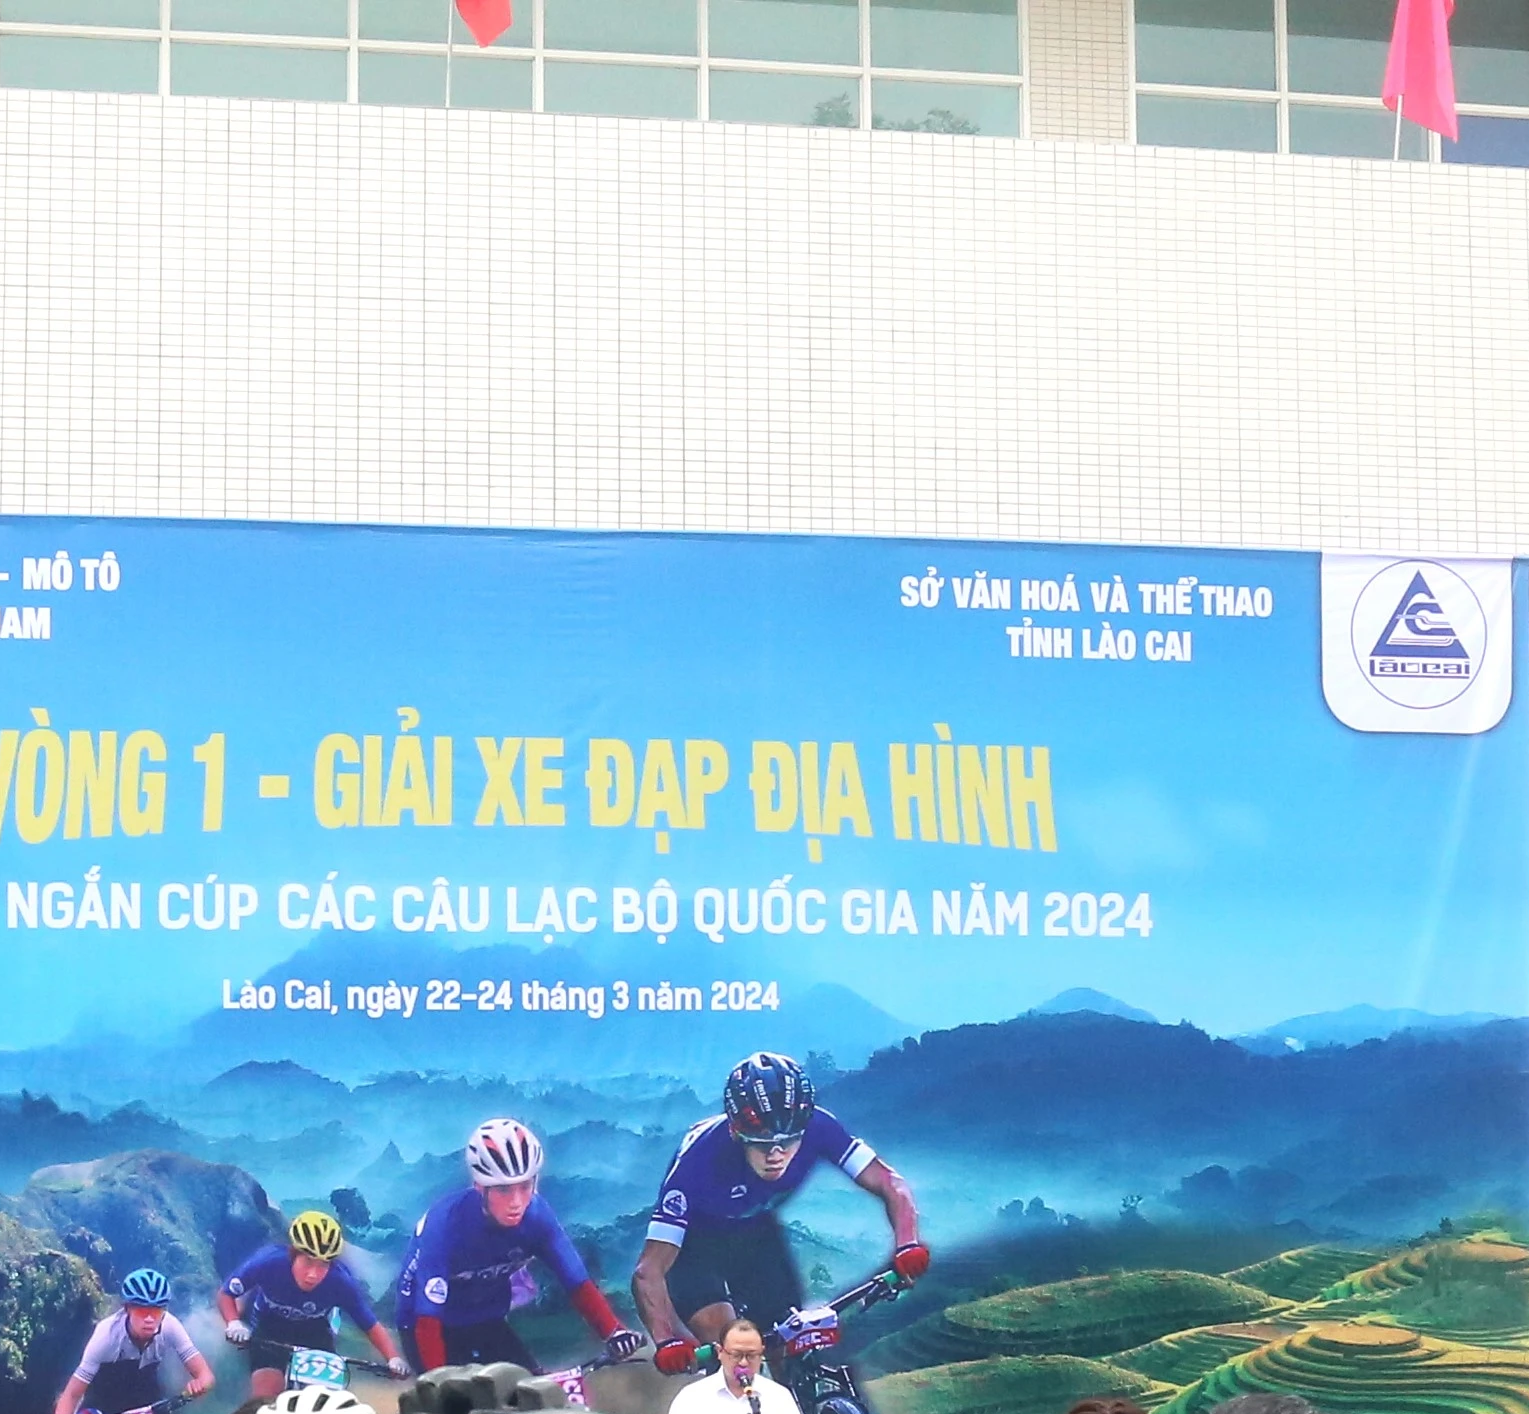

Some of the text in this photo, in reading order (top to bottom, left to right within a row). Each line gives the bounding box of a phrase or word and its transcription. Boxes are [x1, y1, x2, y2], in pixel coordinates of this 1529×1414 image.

[22, 550, 72, 591] MÔ
[79, 551, 121, 591] TÔ
[900, 565, 1273, 617] SỞ VĂN HOÁ VÀ THỂ THAO
[1006, 616, 1192, 662] TỈNH LÀO CAI
[193, 732, 225, 832] 1
[259, 775, 290, 797] -
[313, 706, 453, 828] GIẢI
[474, 736, 565, 826] XE
[585, 737, 729, 854] ĐẠP
[749, 739, 873, 863] ĐỊA
[888, 722, 1058, 852] HÌNH
[6, 864, 141, 930] NGẮN
[158, 874, 258, 930] CÚP
[277, 870, 375, 932] CÁC
[392, 876, 490, 932] CÂU
[507, 885, 597, 944] LẠC
[613, 877, 678, 944] BỘ
[693, 873, 827, 936] QUỐC
[840, 889, 919, 935] GIA
[932, 881, 1028, 936] NĂM
[1044, 891, 1153, 937] 2024
[222, 978, 275, 1010] Lào
[284, 980, 338, 1015] Cai,
[347, 980, 419, 1017] ngày
[521, 981, 605, 1017] tháng
[612, 982, 629, 1012] 3
[637, 983, 702, 1012] năm
[711, 981, 780, 1012] 2024
